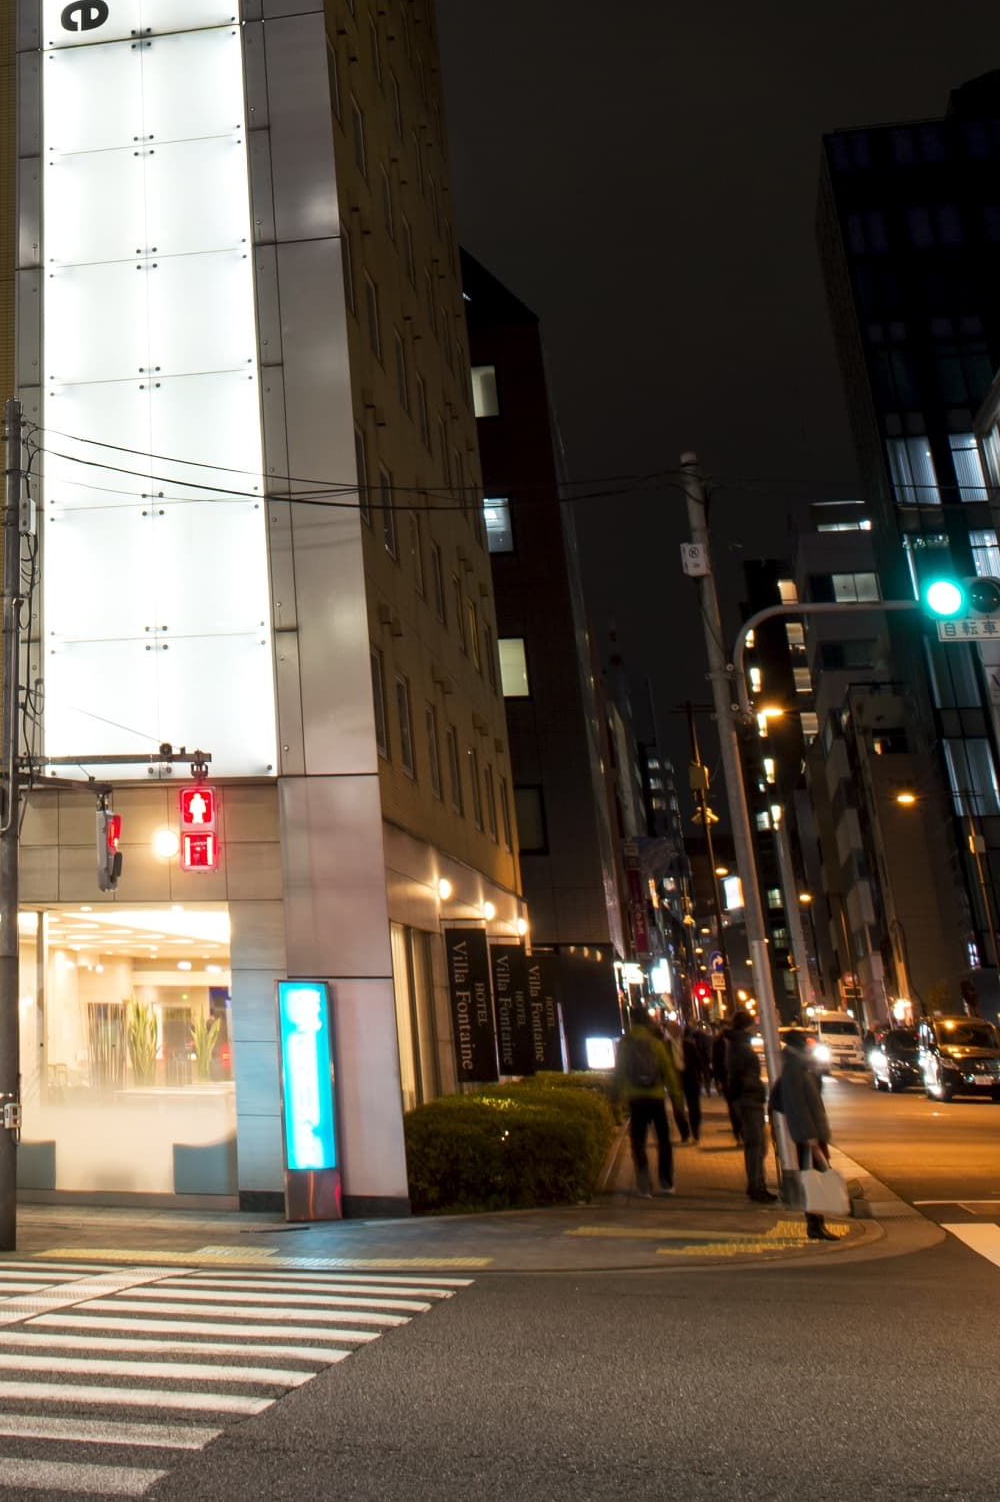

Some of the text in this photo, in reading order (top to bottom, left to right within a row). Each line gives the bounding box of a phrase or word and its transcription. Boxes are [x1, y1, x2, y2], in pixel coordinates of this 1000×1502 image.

[943, 621, 999, 636] 自転車
[452, 941, 475, 1070] Villa Fontaine
[475, 982, 487, 1027] HOTEL
[496, 955, 516, 1066] Villa Fontaine
[515, 990, 526, 1026] HOTEL
[528, 965, 547, 1062] Villa Fontaine
